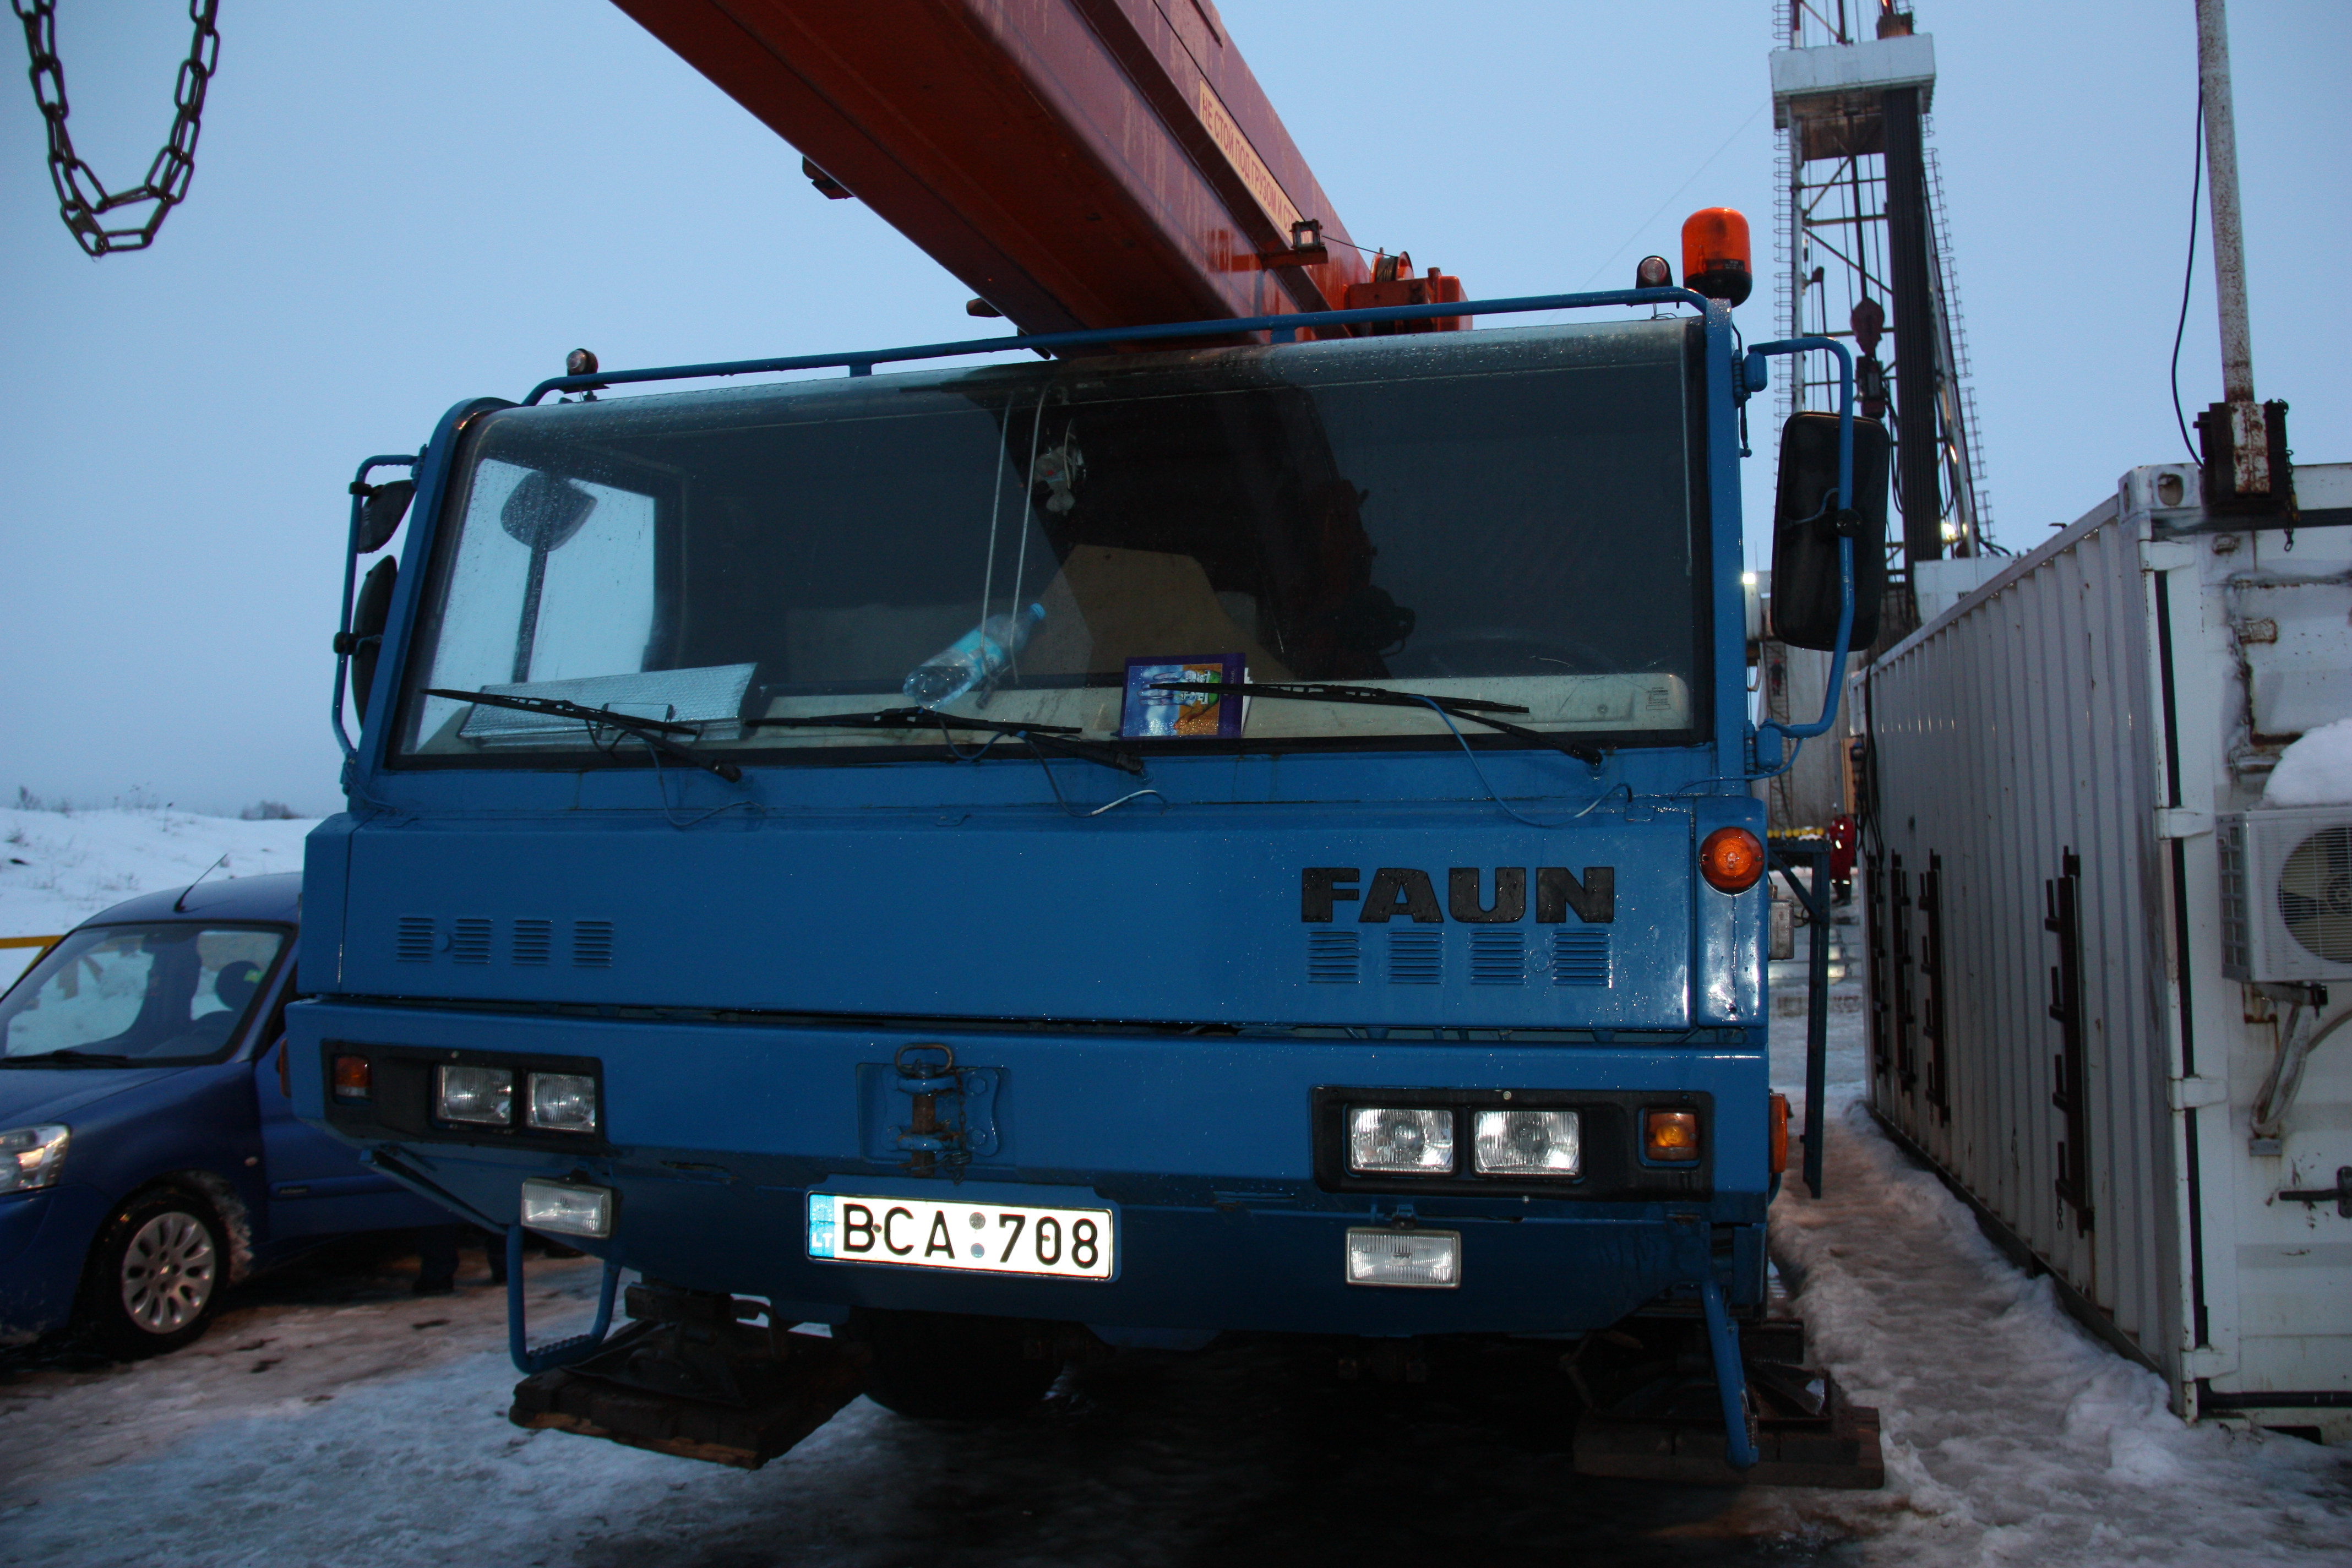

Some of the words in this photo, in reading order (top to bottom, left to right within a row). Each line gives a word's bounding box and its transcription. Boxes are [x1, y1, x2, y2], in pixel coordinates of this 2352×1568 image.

[1202, 92, 1213, 131] НЕ
[1214, 110, 1233, 159] СТОЙ
[1235, 137, 1250, 186] ПОД
[1251, 159, 1277, 215] ГРУЗОМ
[1277, 195, 1282, 222] И
[1302, 867, 1615, 924] FAUN
[812, 1232, 834, 1248] LT
[843, 1203, 956, 1260] BCA
[999, 1213, 1098, 1269] 708
